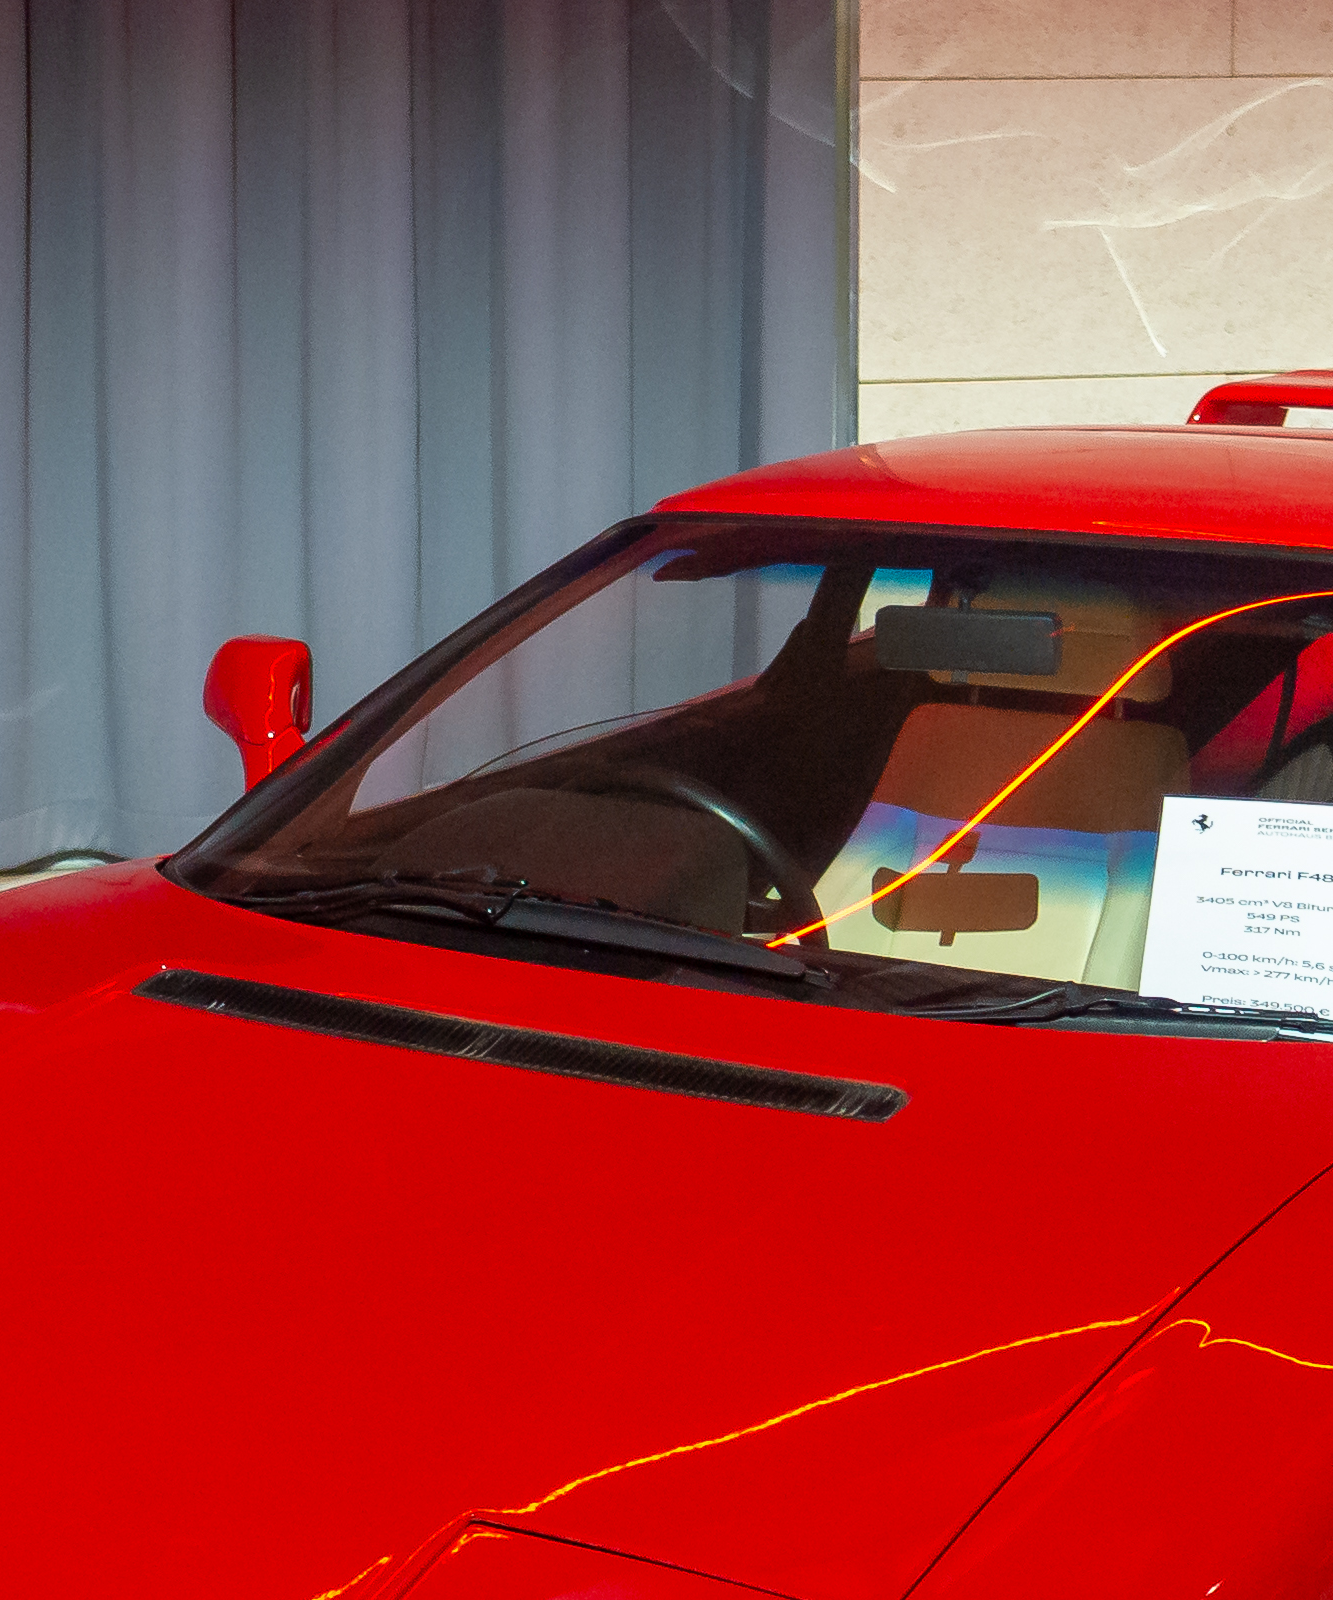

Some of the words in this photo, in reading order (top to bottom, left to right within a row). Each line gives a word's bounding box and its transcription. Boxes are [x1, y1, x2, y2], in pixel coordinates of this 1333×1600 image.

[1258, 817, 1314, 826] OFFICIAL
[1257, 824, 1310, 832] FERRARI
[1257, 830, 1322, 840] AUTOHAUS
[1220, 867, 1292, 880] Ferrari
[1196, 896, 1235, 905] 3405
[1272, 900, 1293, 909] V8
[1246, 912, 1276, 921] 549
[1279, 914, 1301, 923] PS
[1243, 925, 1270, 934] 317
[1274, 928, 1301, 937] Nm
[1202, 951, 1249, 962] 0-100
[1252, 954, 1298, 967] km/h:
[1302, 960, 1326, 971] 5,6
[1200, 964, 1250, 977] Vmax:
[1263, 970, 1291, 980] 277
[1201, 995, 1247, 1006] Preis:
